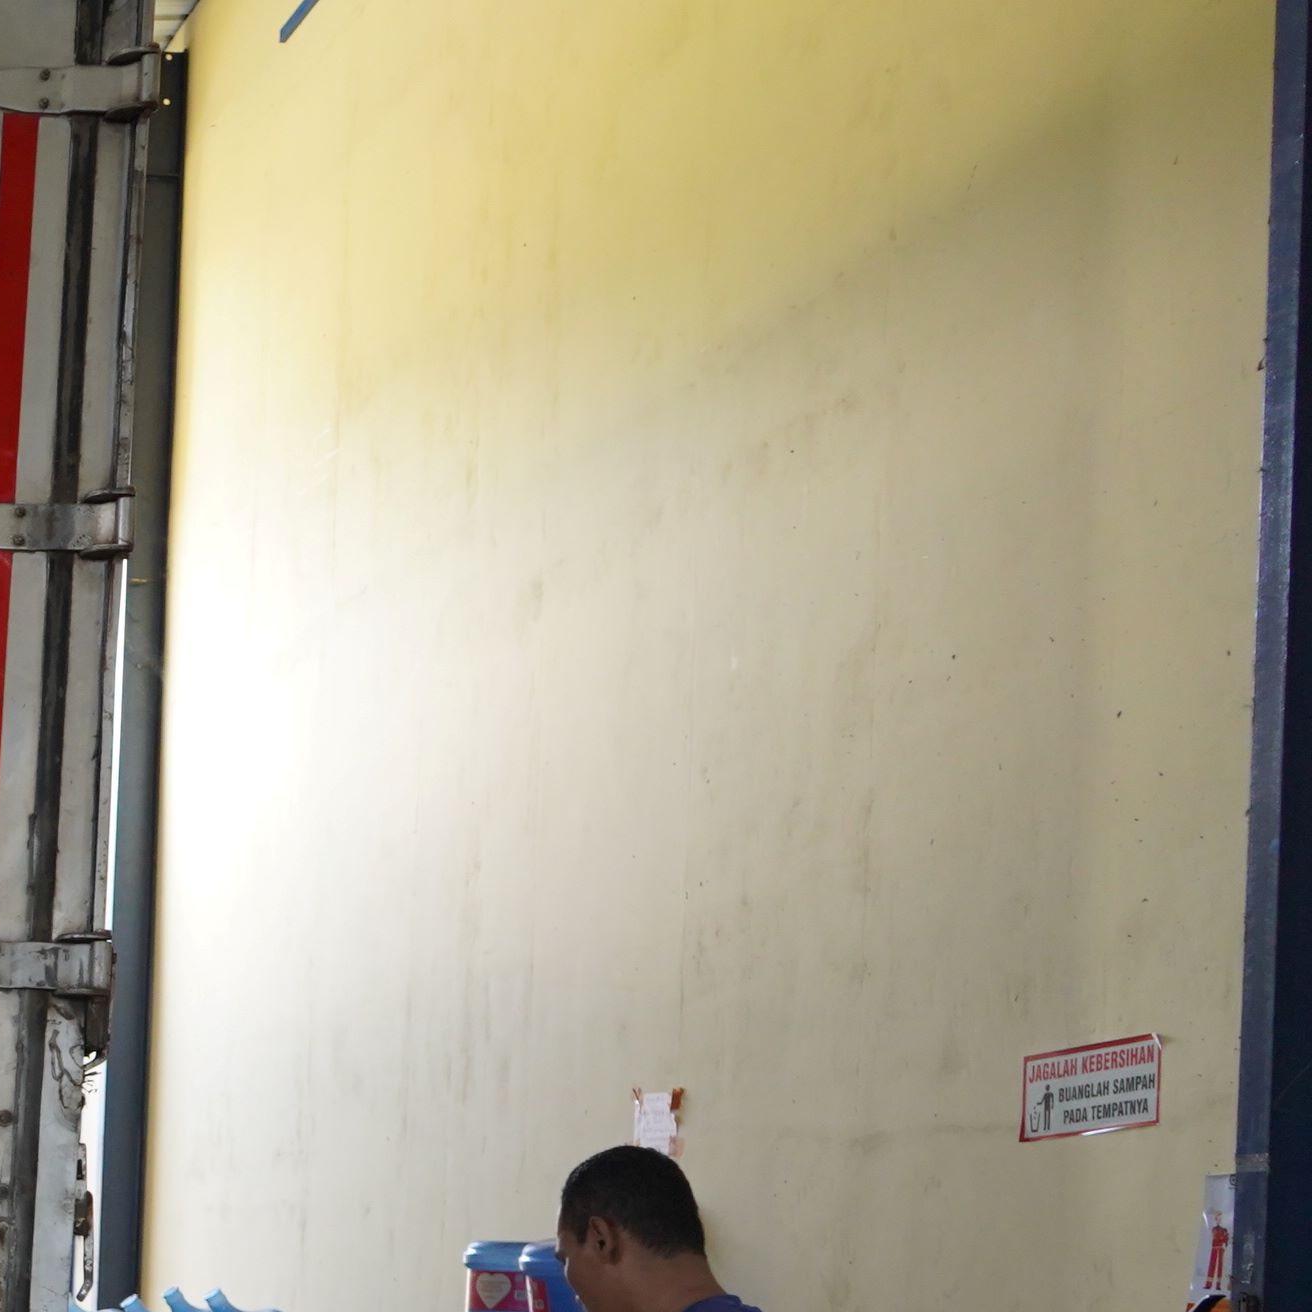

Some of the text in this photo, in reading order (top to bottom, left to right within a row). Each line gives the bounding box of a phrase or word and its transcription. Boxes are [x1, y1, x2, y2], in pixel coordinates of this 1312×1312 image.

[1029, 1045, 1155, 1083] JAGALAH KEBERSIHAN
[1058, 1073, 1156, 1103] BUANGLAH SAMPAH
[1063, 1097, 1149, 1124] PADA TEMPATNYA
